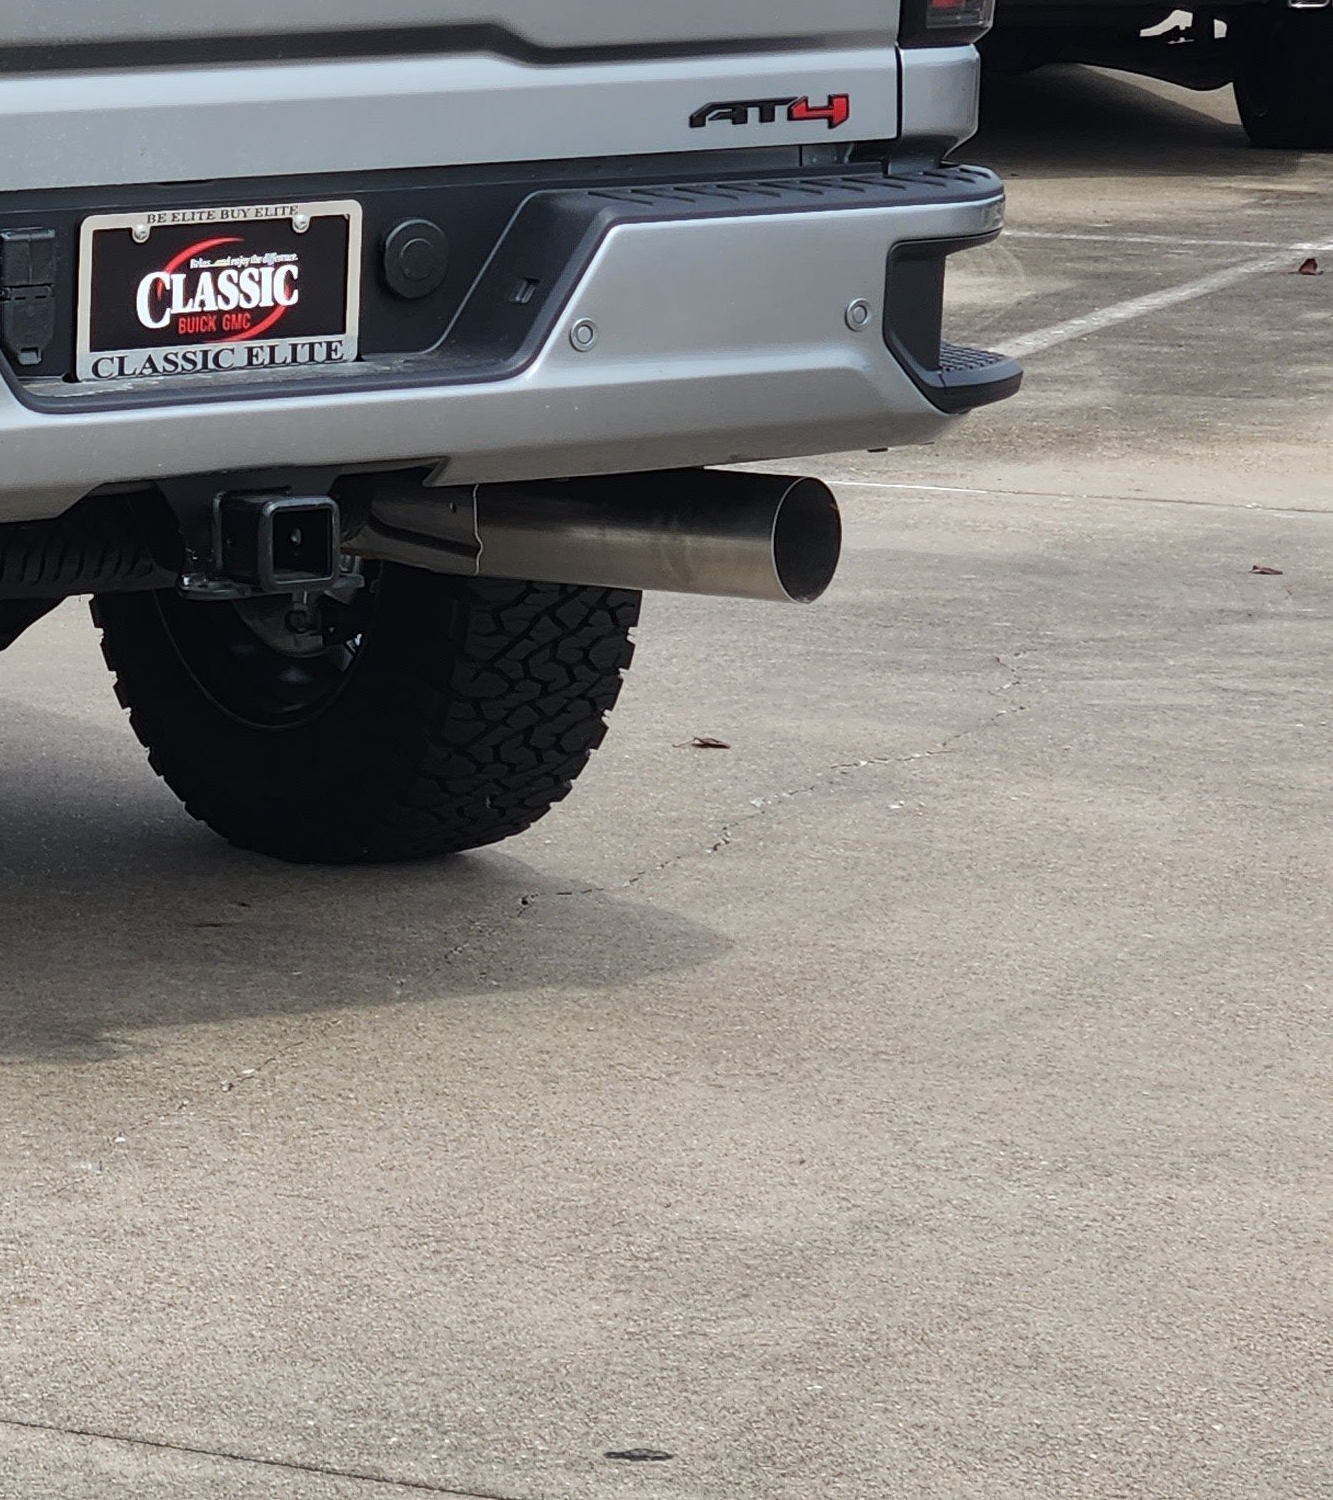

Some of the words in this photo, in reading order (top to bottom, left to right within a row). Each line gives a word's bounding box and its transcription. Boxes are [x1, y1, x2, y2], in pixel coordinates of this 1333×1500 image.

[687, 93, 850, 129] AT4
[147, 214, 167, 224] BE
[171, 210, 215, 222] ELITE
[220, 208, 251, 219] BUY
[254, 205, 299, 217] ELITE
[136, 264, 299, 329] CLASSIC
[178, 314, 217, 334] BUICK
[222, 313, 251, 332] GMC
[91, 348, 235, 379] CLASSIC
[246, 340, 345, 367] ELITE
